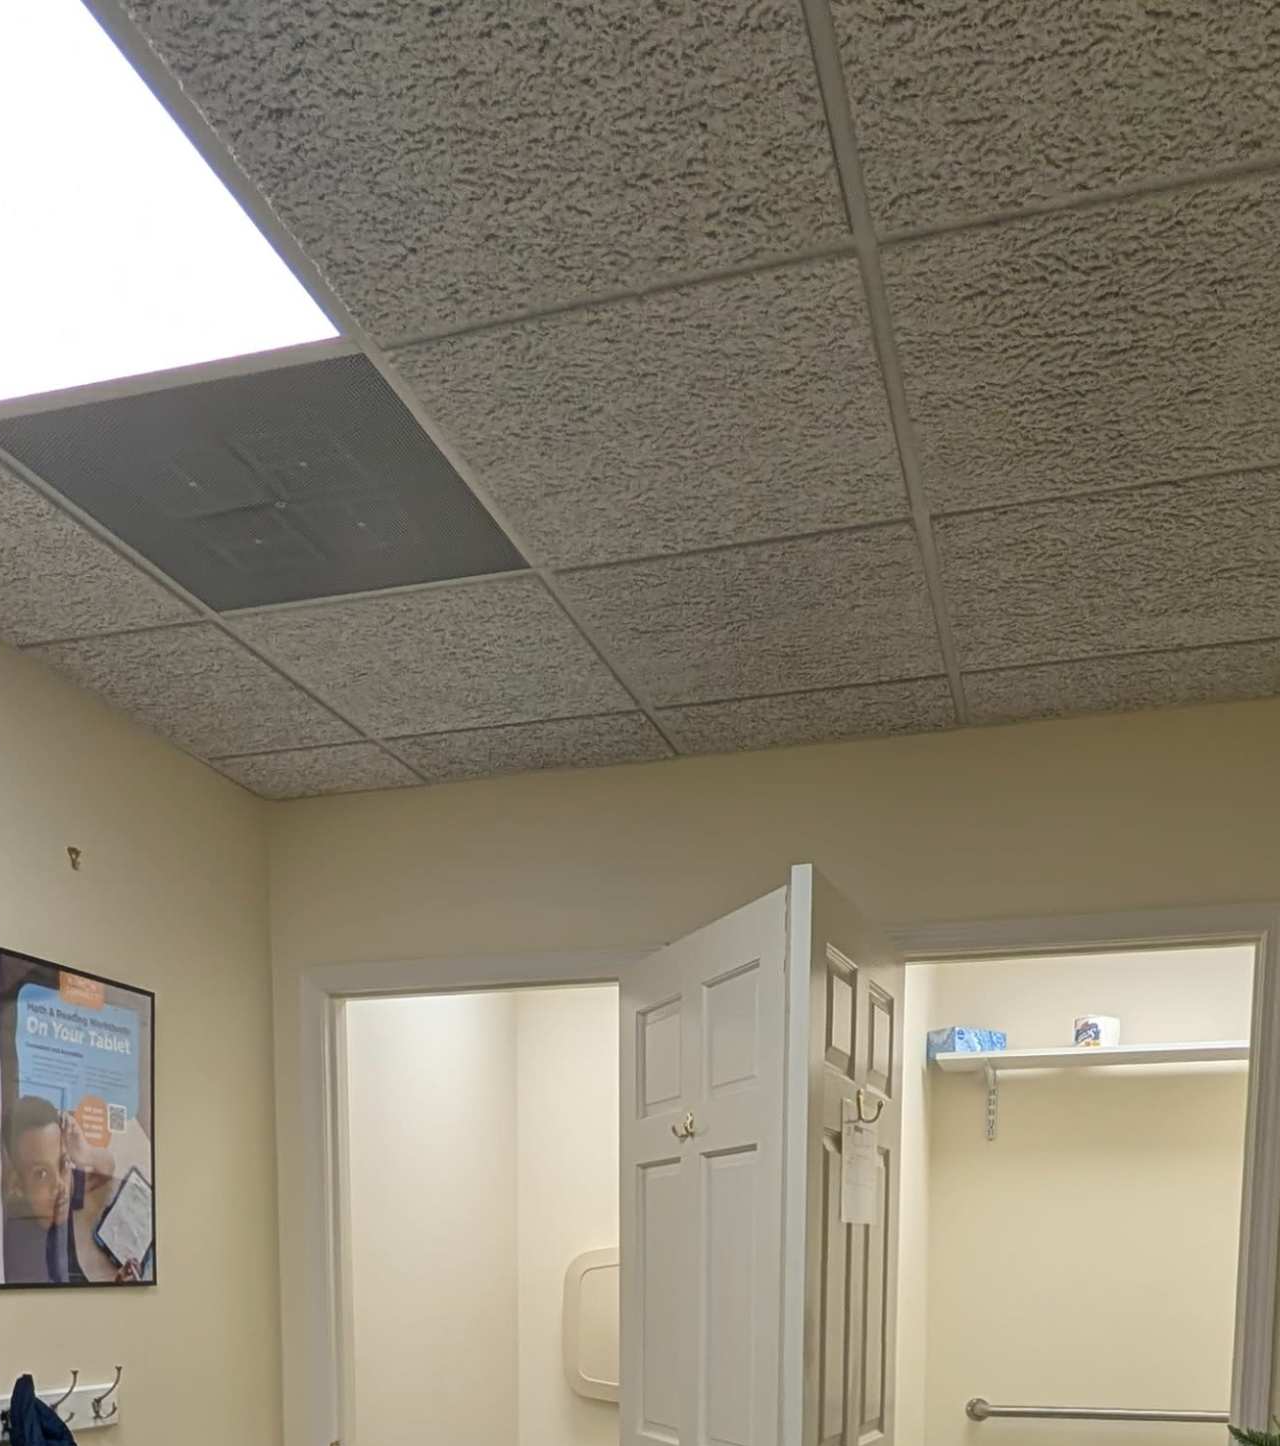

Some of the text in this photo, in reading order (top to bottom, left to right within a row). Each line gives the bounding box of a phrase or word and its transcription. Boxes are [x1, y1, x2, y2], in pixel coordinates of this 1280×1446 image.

[26, 1001, 47, 1015] Math
[56, 1009, 88, 1027] Reading
[26, 1016, 48, 1036] On
[51, 1021, 84, 1045] Your
[87, 1030, 132, 1055] Tablet
